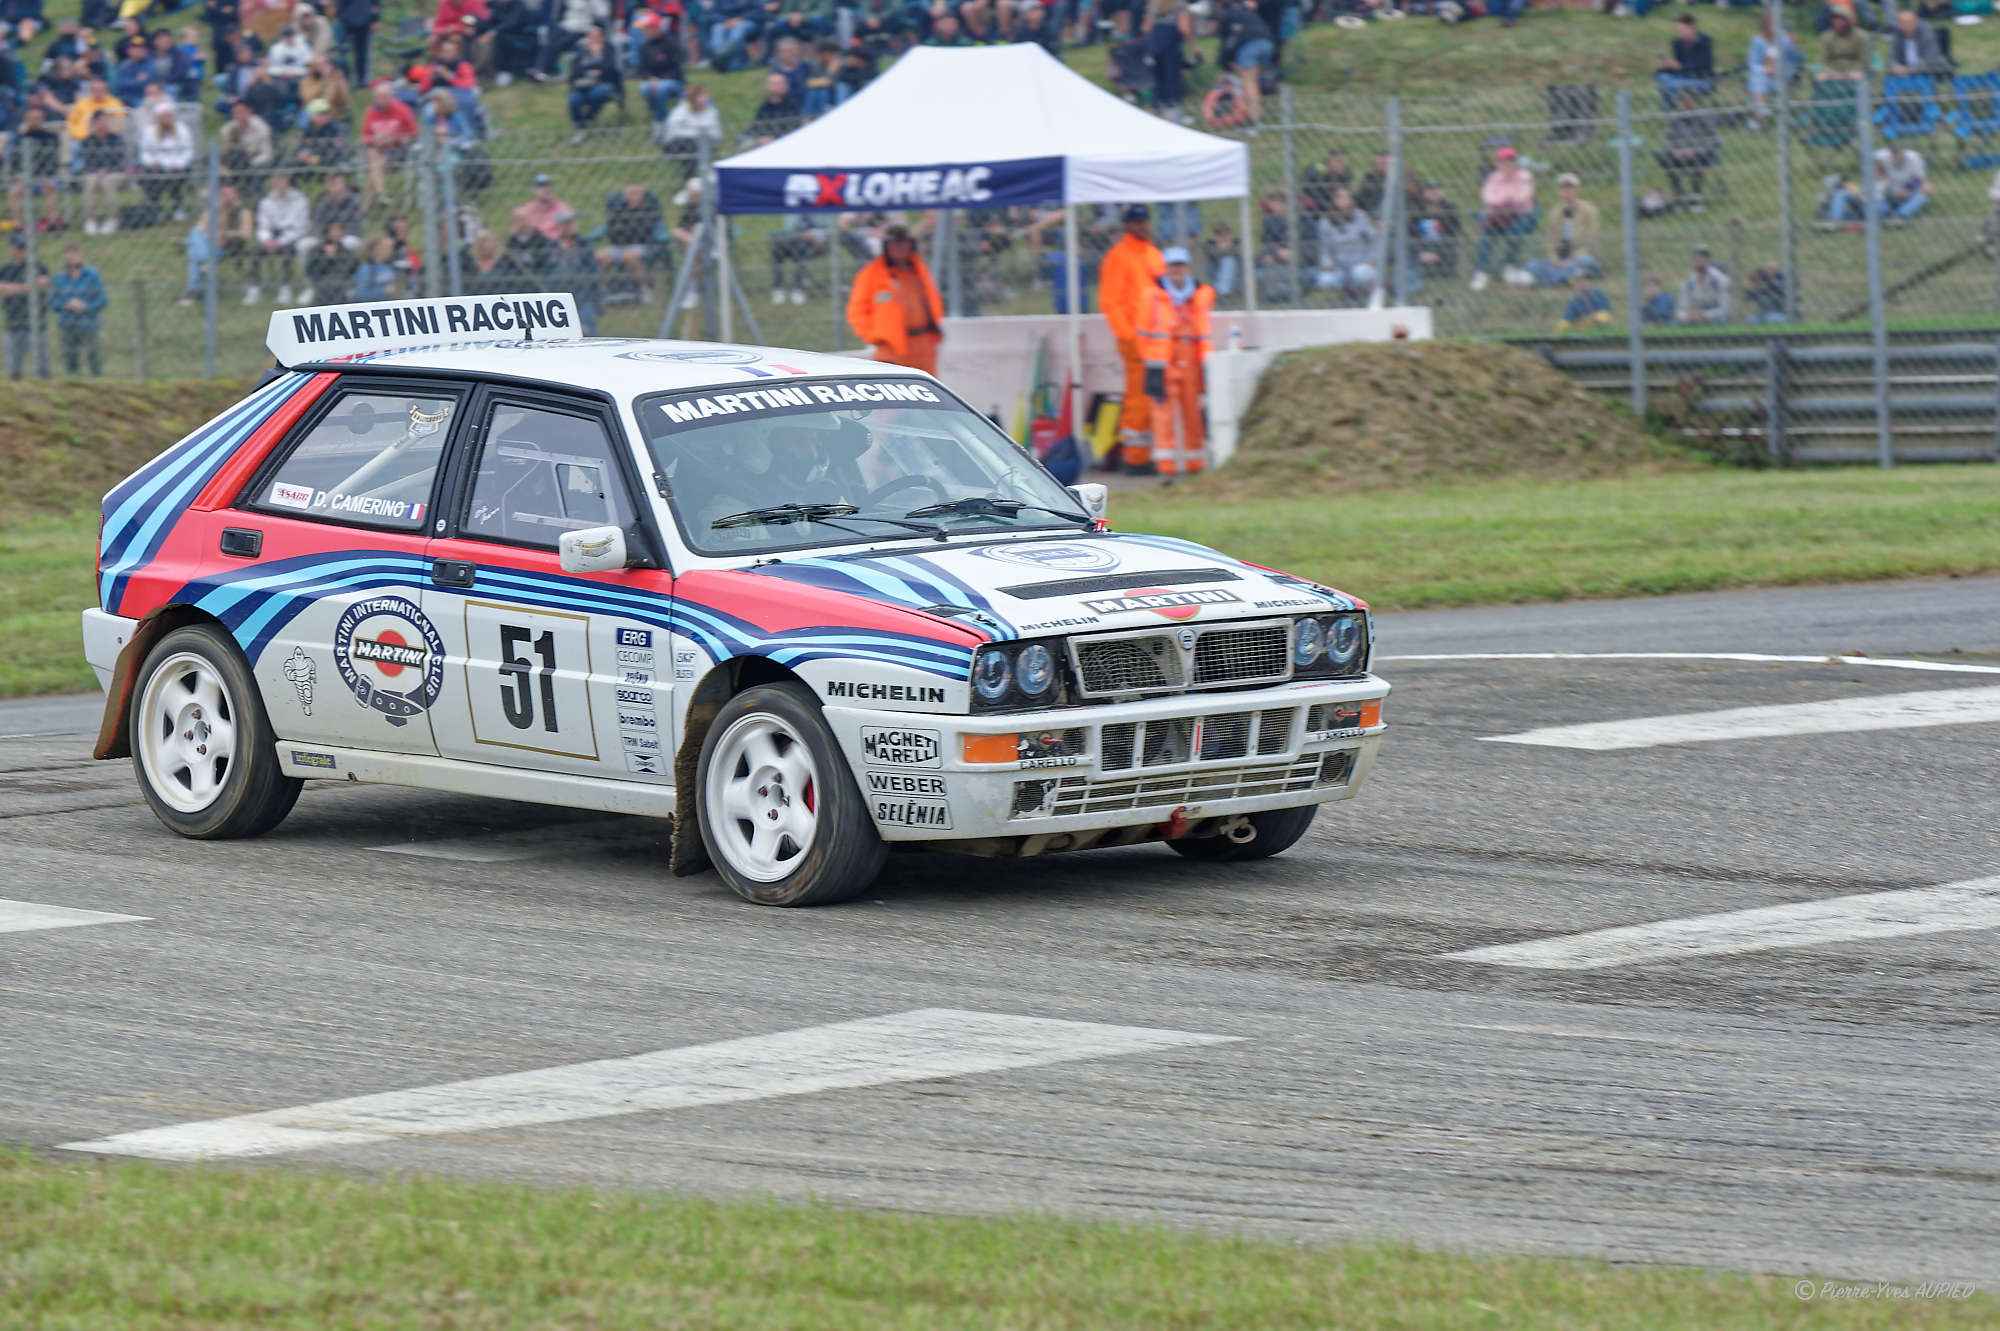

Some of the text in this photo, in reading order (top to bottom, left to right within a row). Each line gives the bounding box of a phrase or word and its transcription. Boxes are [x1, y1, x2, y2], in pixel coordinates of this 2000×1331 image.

[293, 299, 570, 343] MARTINI RACING
[660, 383, 941, 424] MARTINI RACING
[314, 491, 327, 508] D.
[331, 494, 405, 518] CAMERINO
[1087, 589, 1237, 614] MARTINI
[1254, 597, 1323, 609] MICHELIN
[1019, 616, 1100, 631] MICHELIN
[336, 599, 441, 697] MARTINI INTERNATIONAL CLUB
[622, 630, 648, 646] ERG
[356, 641, 425, 665] MARTINI
[618, 650, 654, 664] CECOMP
[499, 624, 559, 733] 51
[617, 689, 653, 704] sparco
[827, 681, 945, 703] MICHELIN
[619, 712, 656, 727] brembo
[867, 774, 946, 793] WEBER
